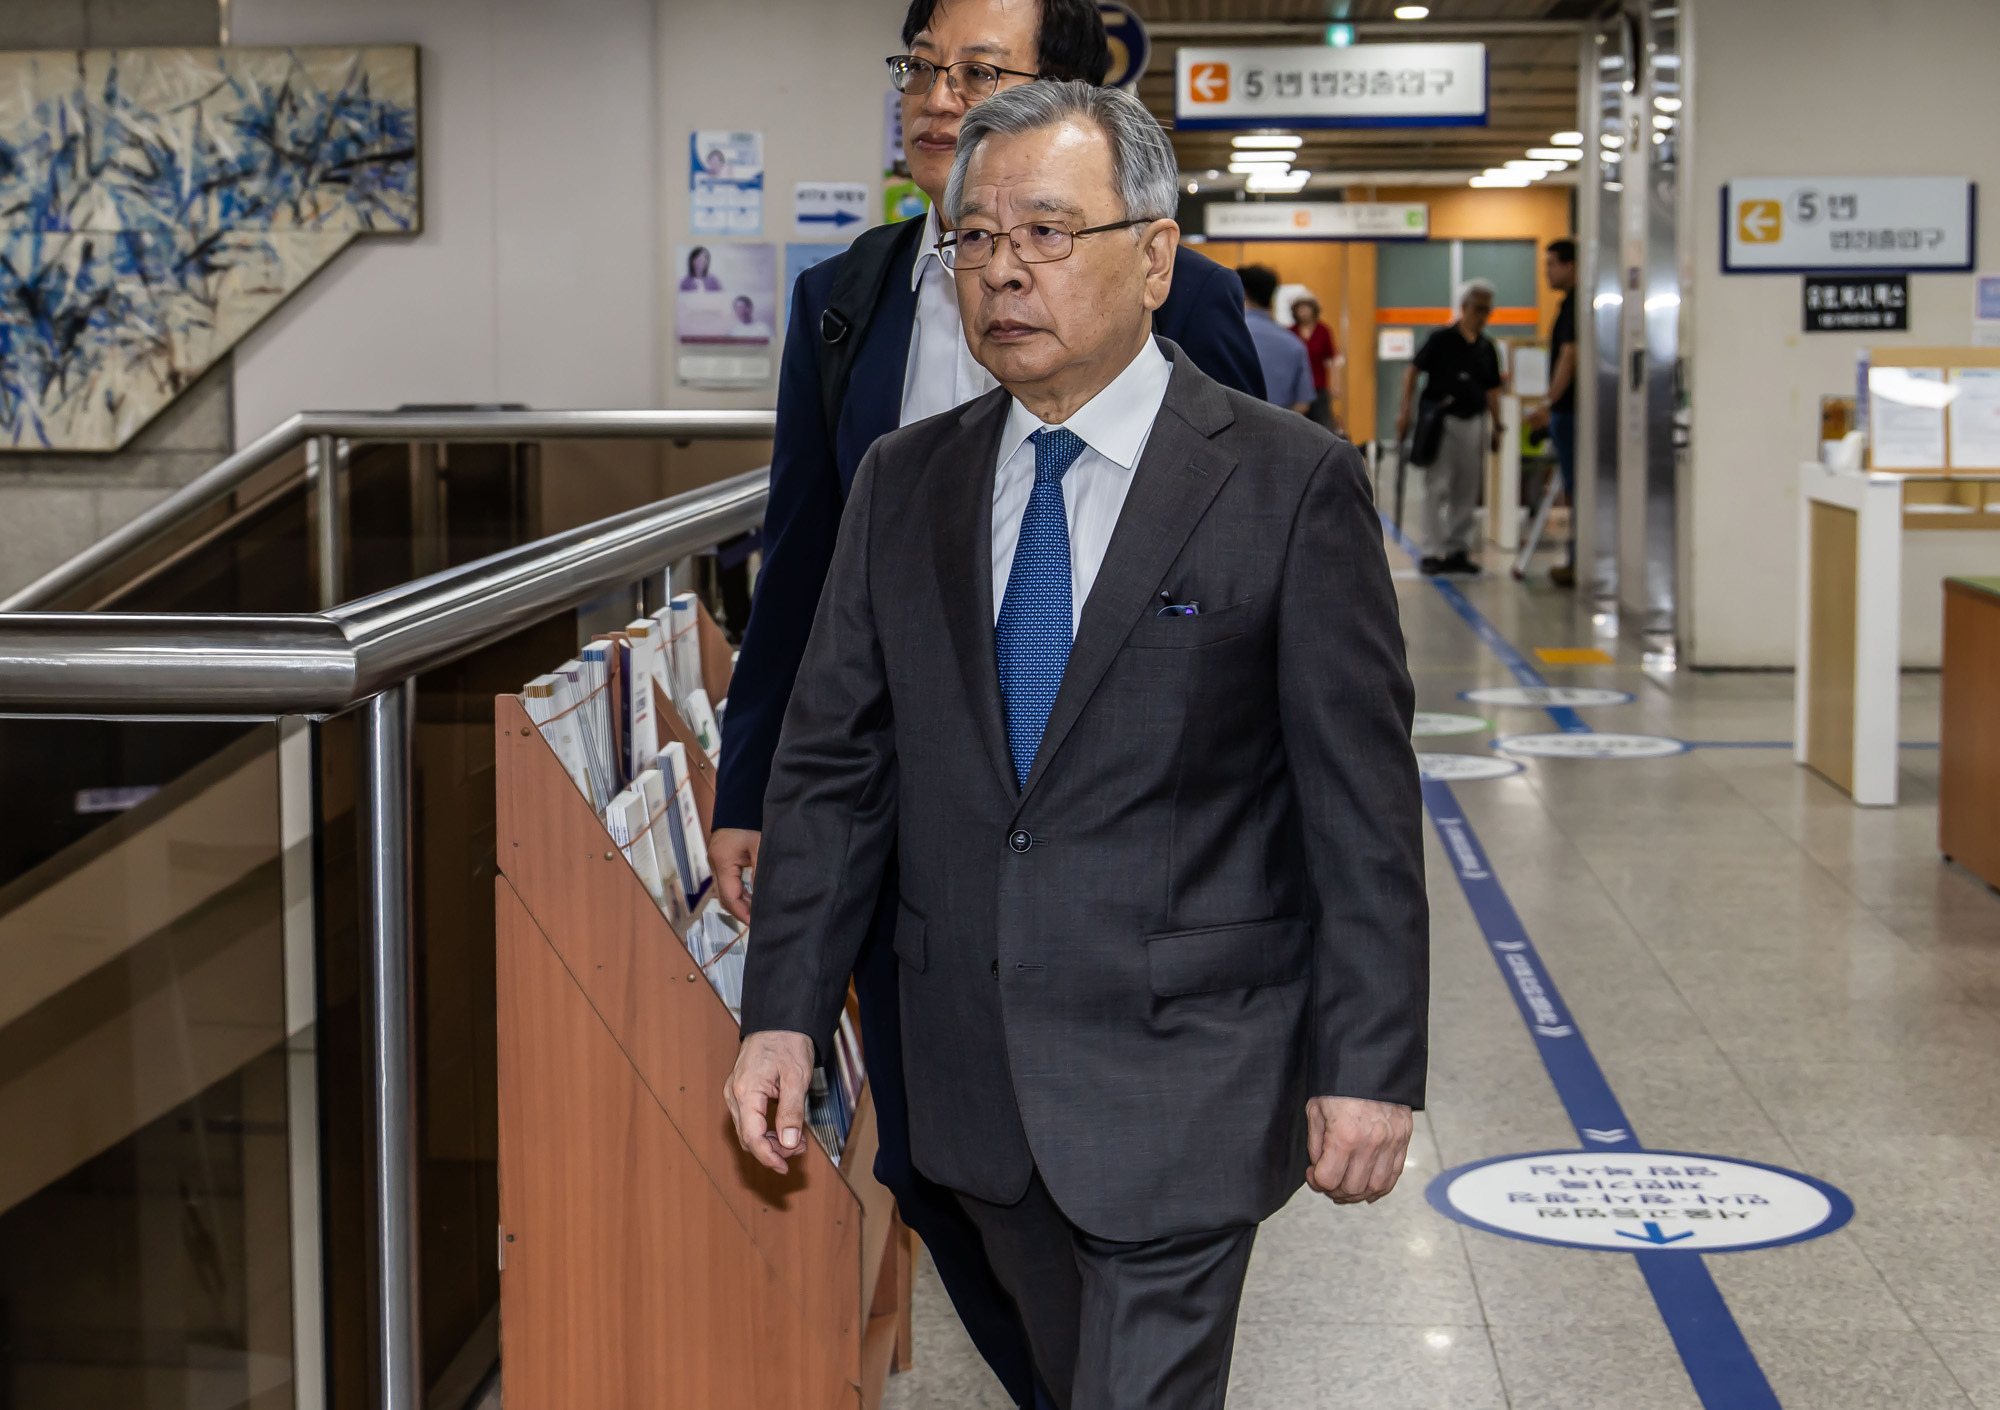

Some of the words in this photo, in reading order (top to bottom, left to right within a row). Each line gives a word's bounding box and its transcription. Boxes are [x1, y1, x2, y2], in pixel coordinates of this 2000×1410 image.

[1246, 70, 1264, 98] 5
[1311, 69, 1454, 98] 법정출입구
[1797, 192, 1817, 221] 5
[1558, 1179, 1704, 1191] 재판기록
[1537, 1207, 1751, 1220] 서울고등법원
